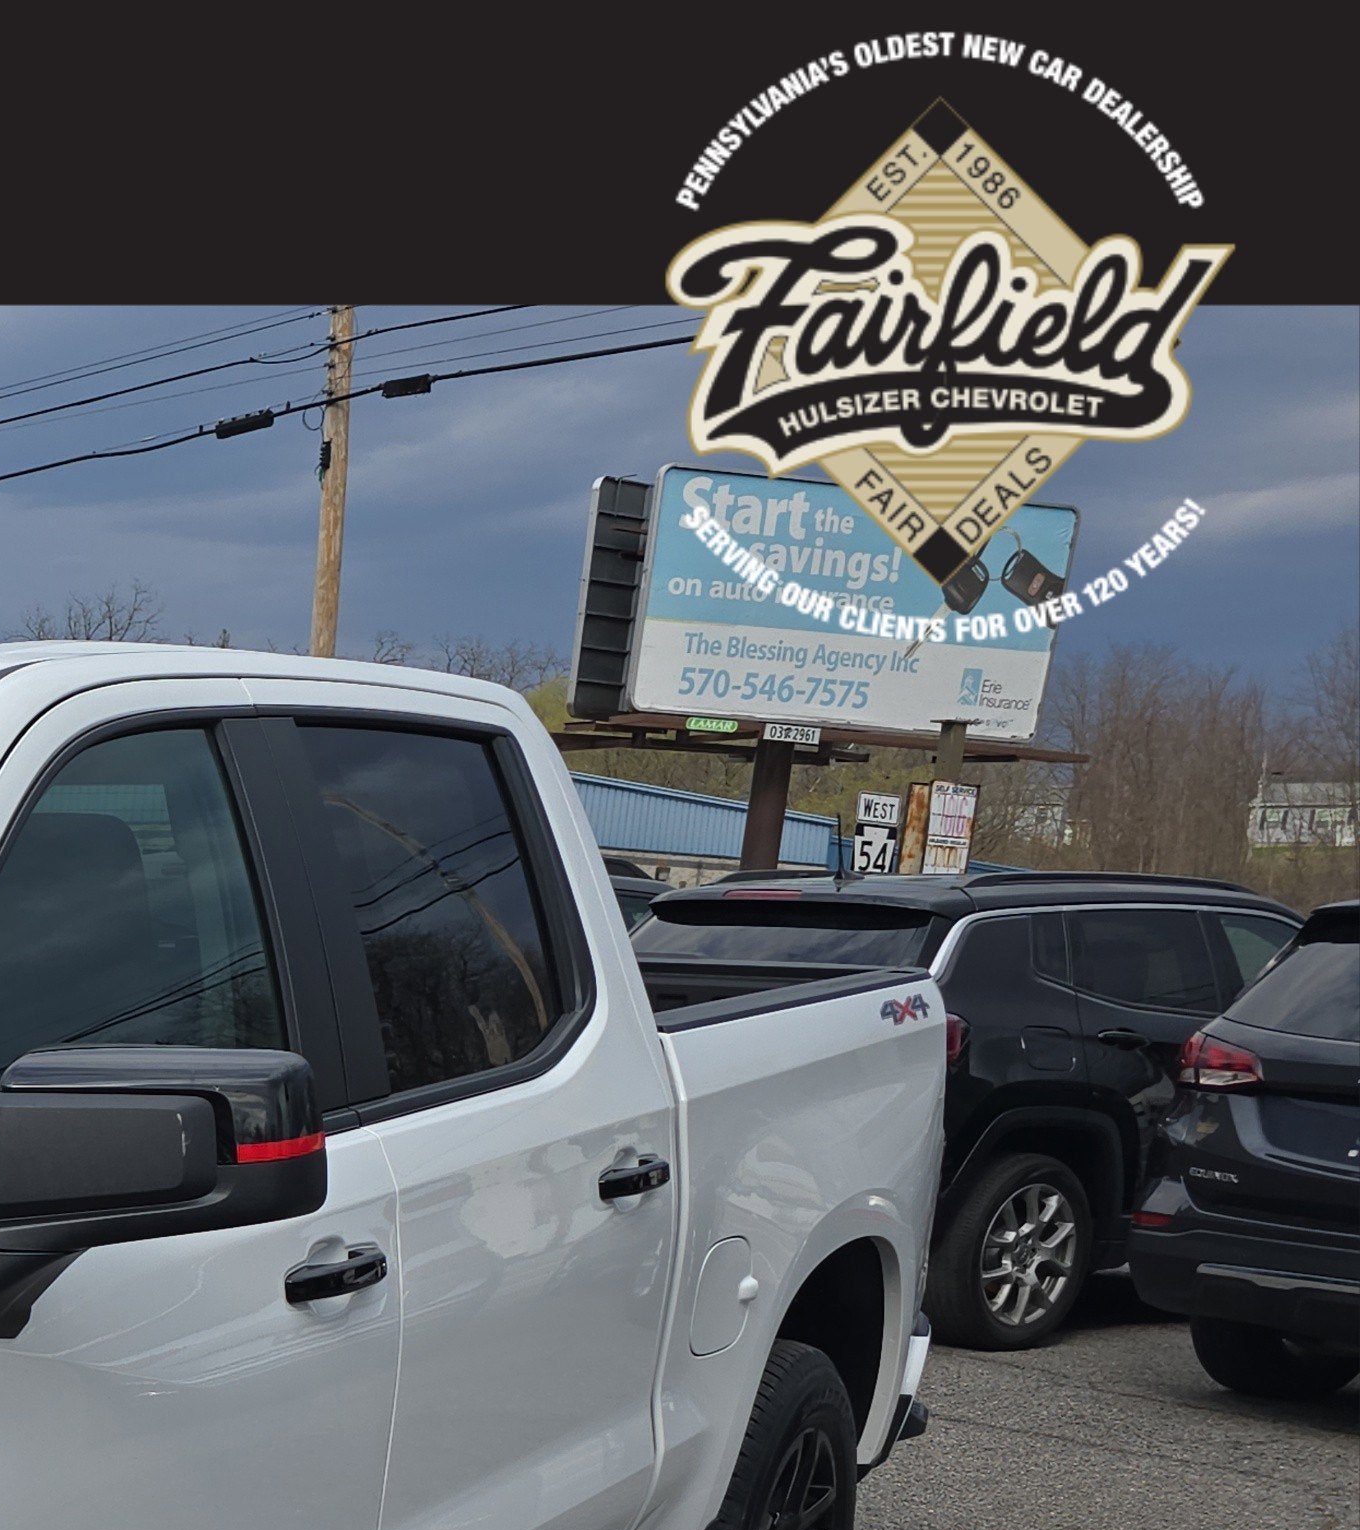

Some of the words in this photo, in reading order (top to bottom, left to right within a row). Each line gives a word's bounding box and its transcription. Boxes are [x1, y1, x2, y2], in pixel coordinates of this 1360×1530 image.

[679, 476, 810, 540] Start
[813, 507, 855, 535] the
[748, 537, 903, 590] savings!
[668, 577, 702, 597] on
[709, 579, 769, 602] auto
[685, 632, 722, 656] The
[726, 636, 808, 669] Blessing
[811, 644, 887, 676] Agency
[890, 651, 920, 674] Inc
[678, 666, 870, 710] 570-546-7575
[979, 694, 1032, 711] Insurance
[863, 798, 895, 820] WEST
[858, 840, 889, 872] 54
